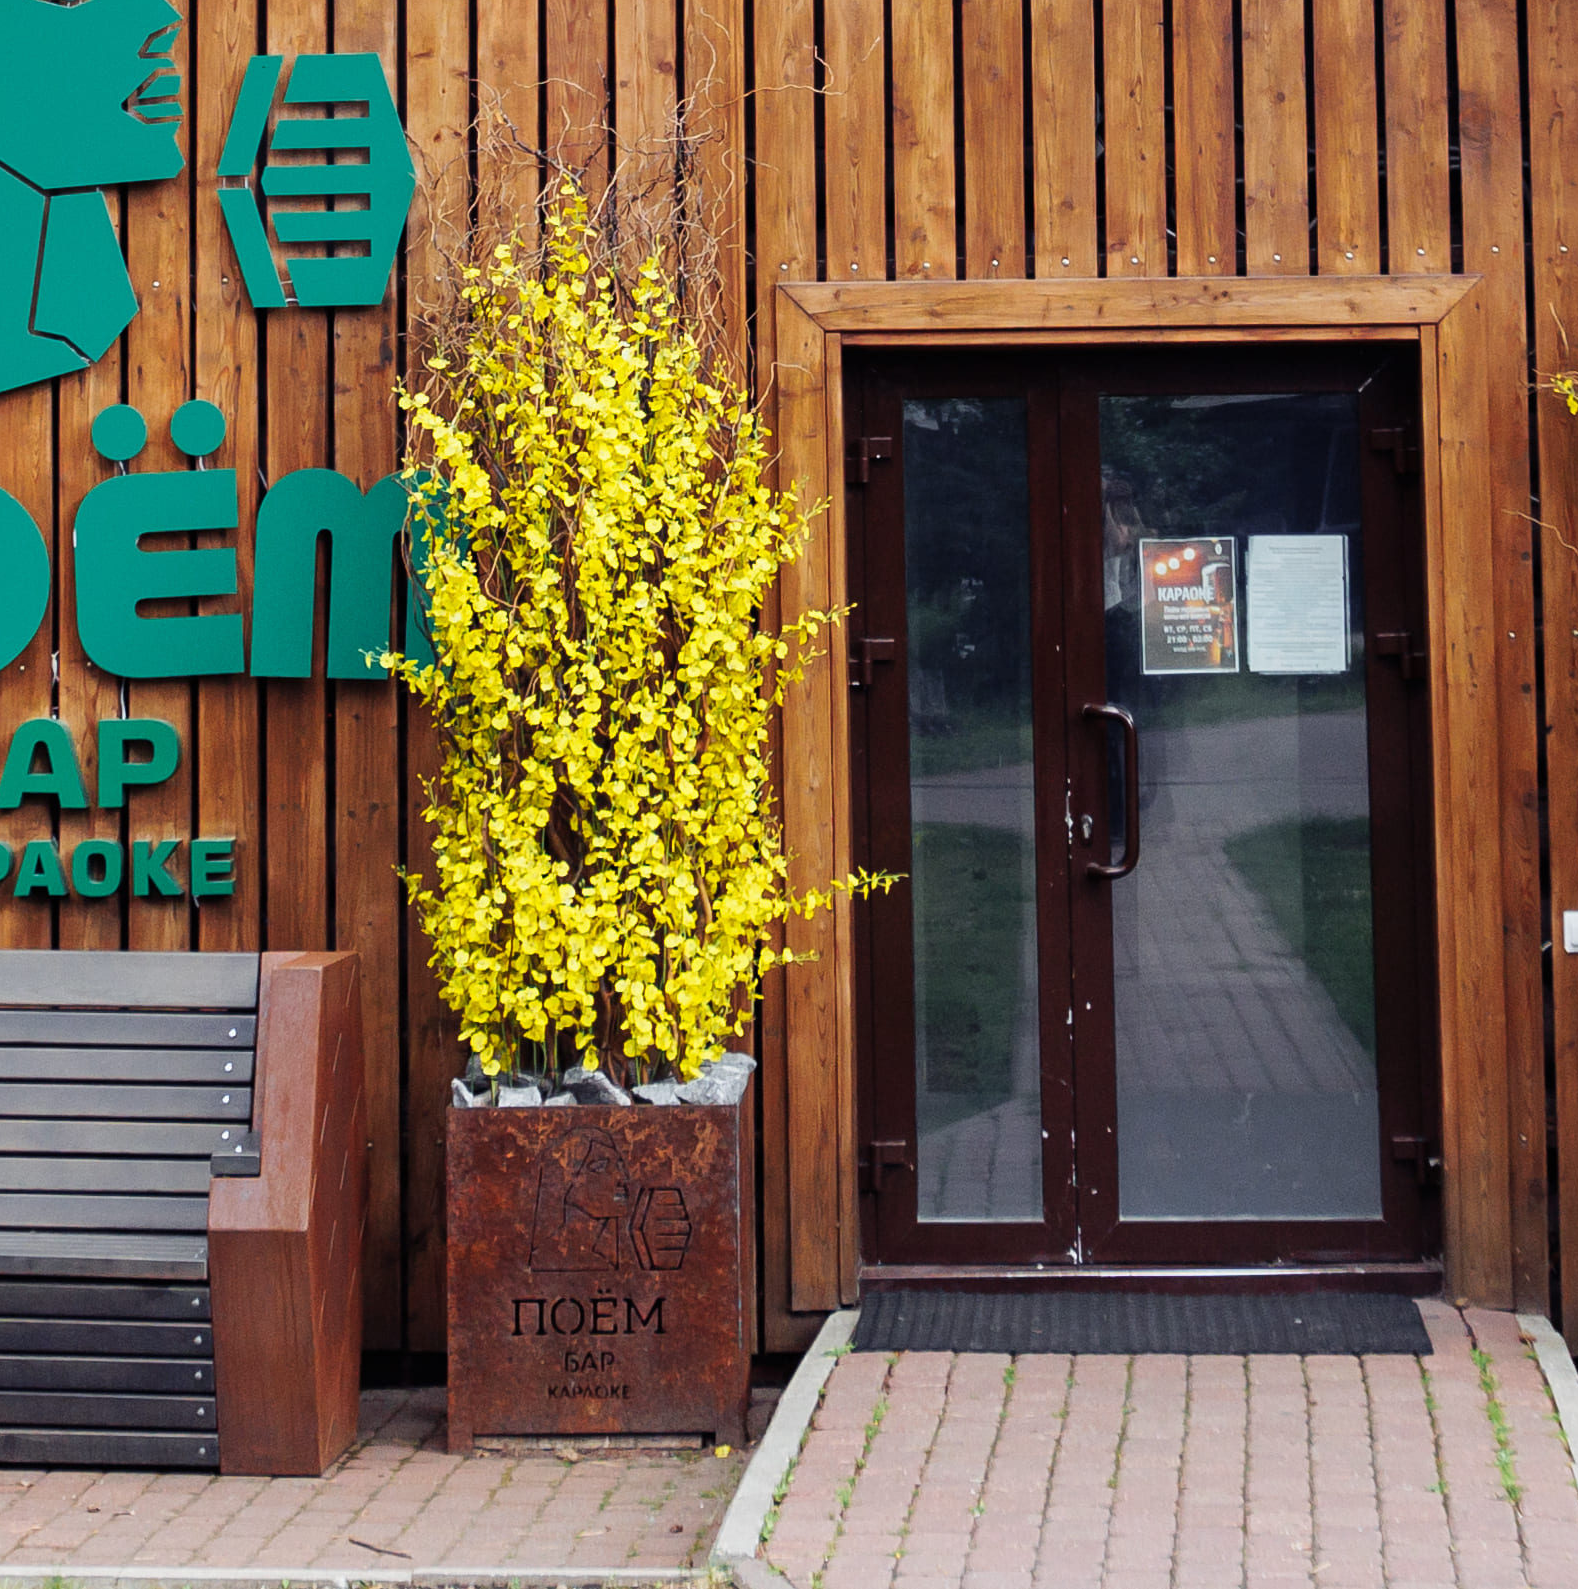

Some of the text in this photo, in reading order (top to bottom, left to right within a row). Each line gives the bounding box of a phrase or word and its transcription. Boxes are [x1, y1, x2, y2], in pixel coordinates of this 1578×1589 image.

[1158, 585, 1215, 602] КАРАОКЕ
[511, 1288, 666, 1337] ПОЁМ
[564, 1352, 615, 1373] БАР
[547, 1385, 631, 1400] КАРАОКЕ
